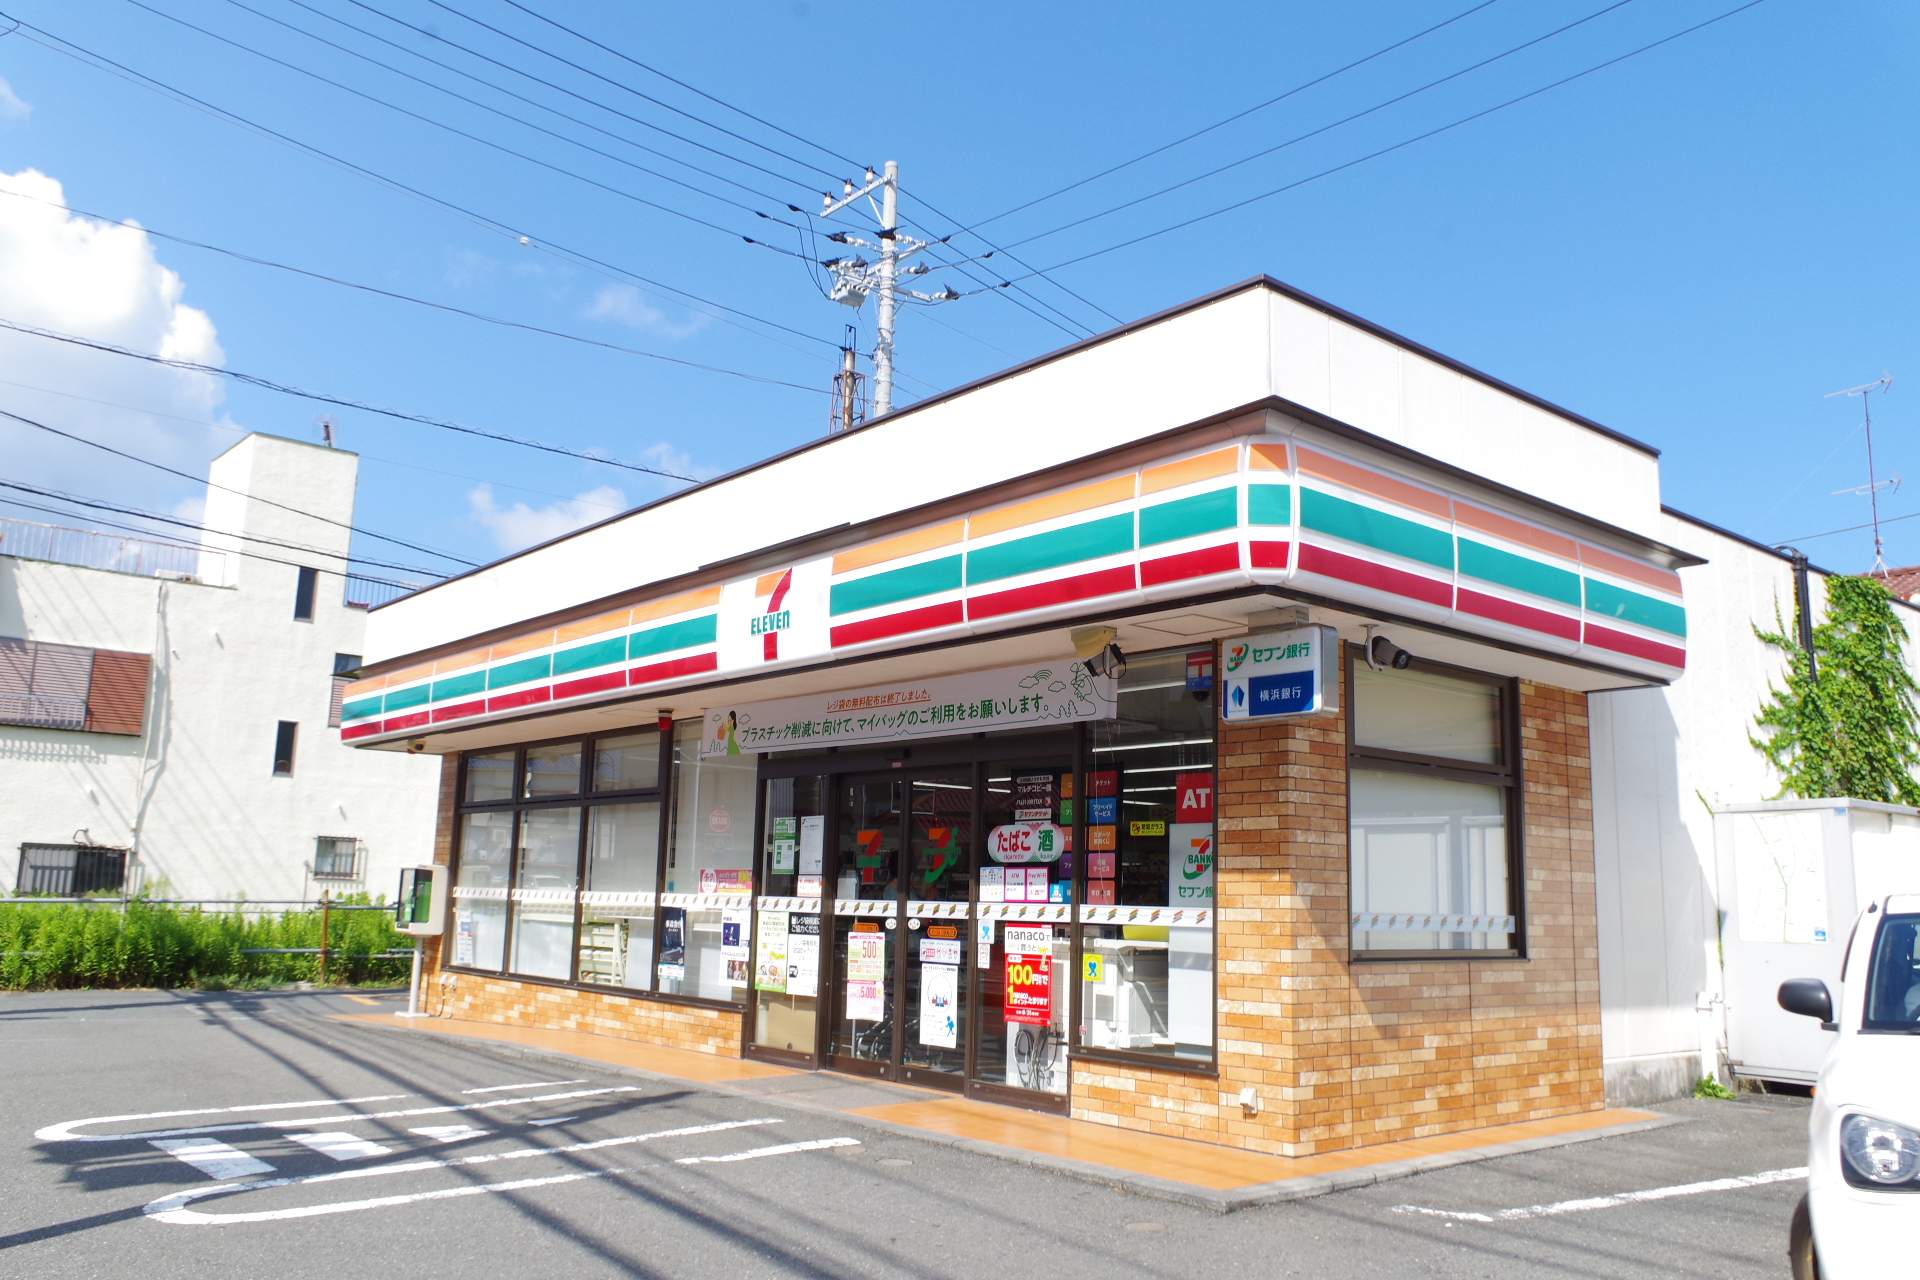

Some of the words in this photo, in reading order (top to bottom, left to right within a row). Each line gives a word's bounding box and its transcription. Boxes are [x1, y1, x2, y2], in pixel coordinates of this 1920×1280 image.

[1252, 642, 1310, 664] セブン銀行
[1260, 687, 1302, 702] 横浜銀行
[741, 693, 1050, 744] プラスチック削減に向けて、マイバッグのご利用をお願いします。
[1182, 788, 1213, 809] AT
[997, 830, 1031, 852] たばこ
[1038, 829, 1053, 852] 酒
[862, 941, 877, 959] 500
